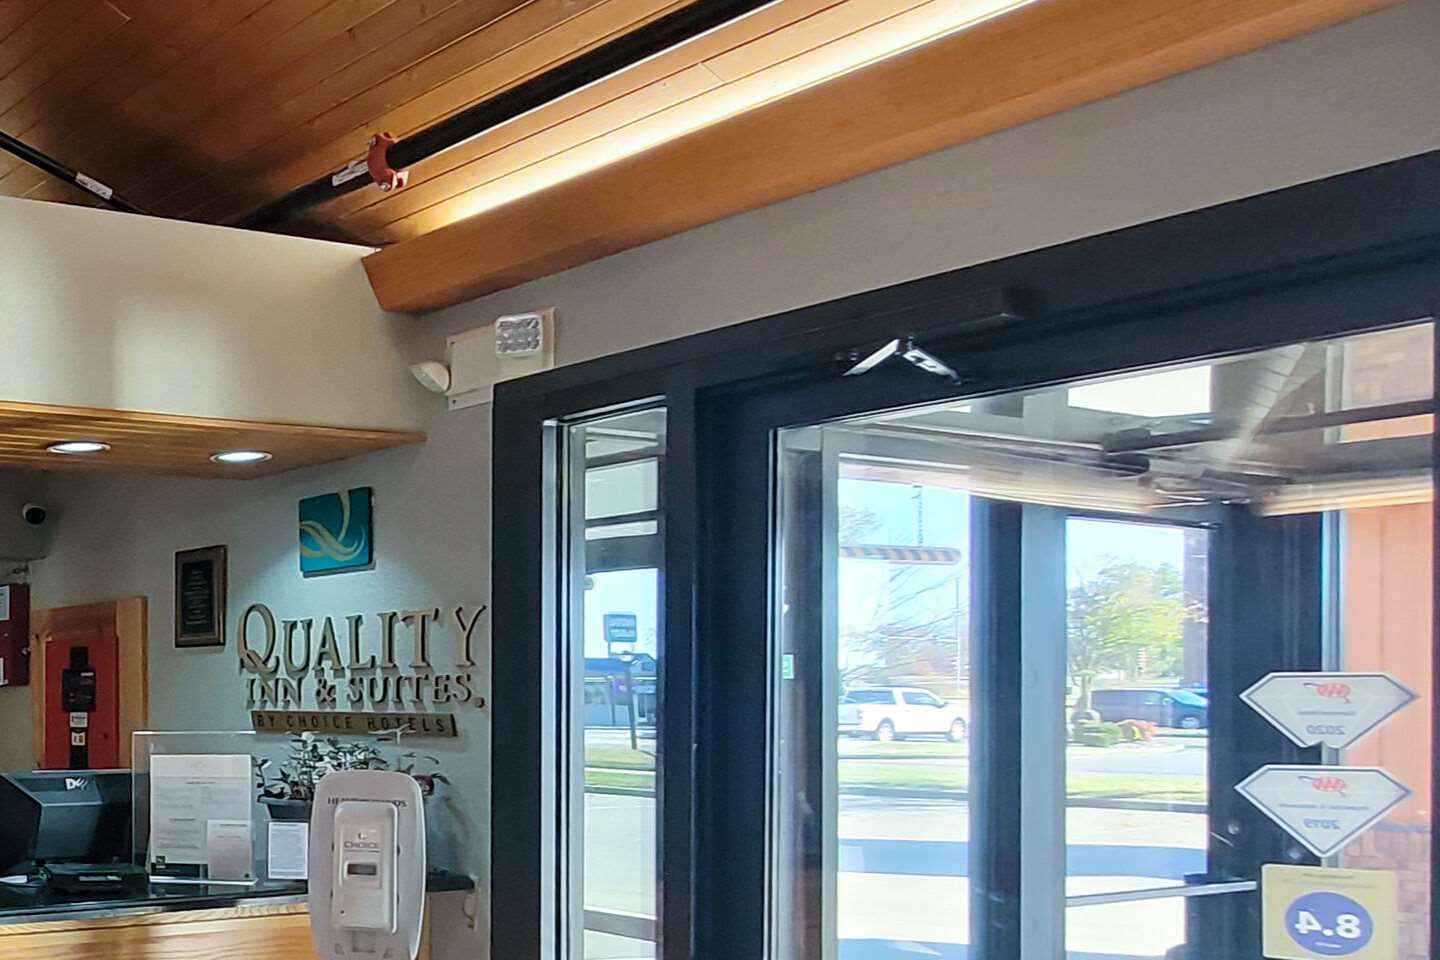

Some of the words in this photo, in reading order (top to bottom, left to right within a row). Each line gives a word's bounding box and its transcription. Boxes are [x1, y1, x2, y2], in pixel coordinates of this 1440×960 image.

[237, 603, 487, 676] QUALITY
[246, 677, 304, 707] INN
[317, 678, 337, 702] &
[258, 713, 275, 727] BY
[287, 714, 353, 730] CHOICE
[367, 717, 446, 733] HOTELS
